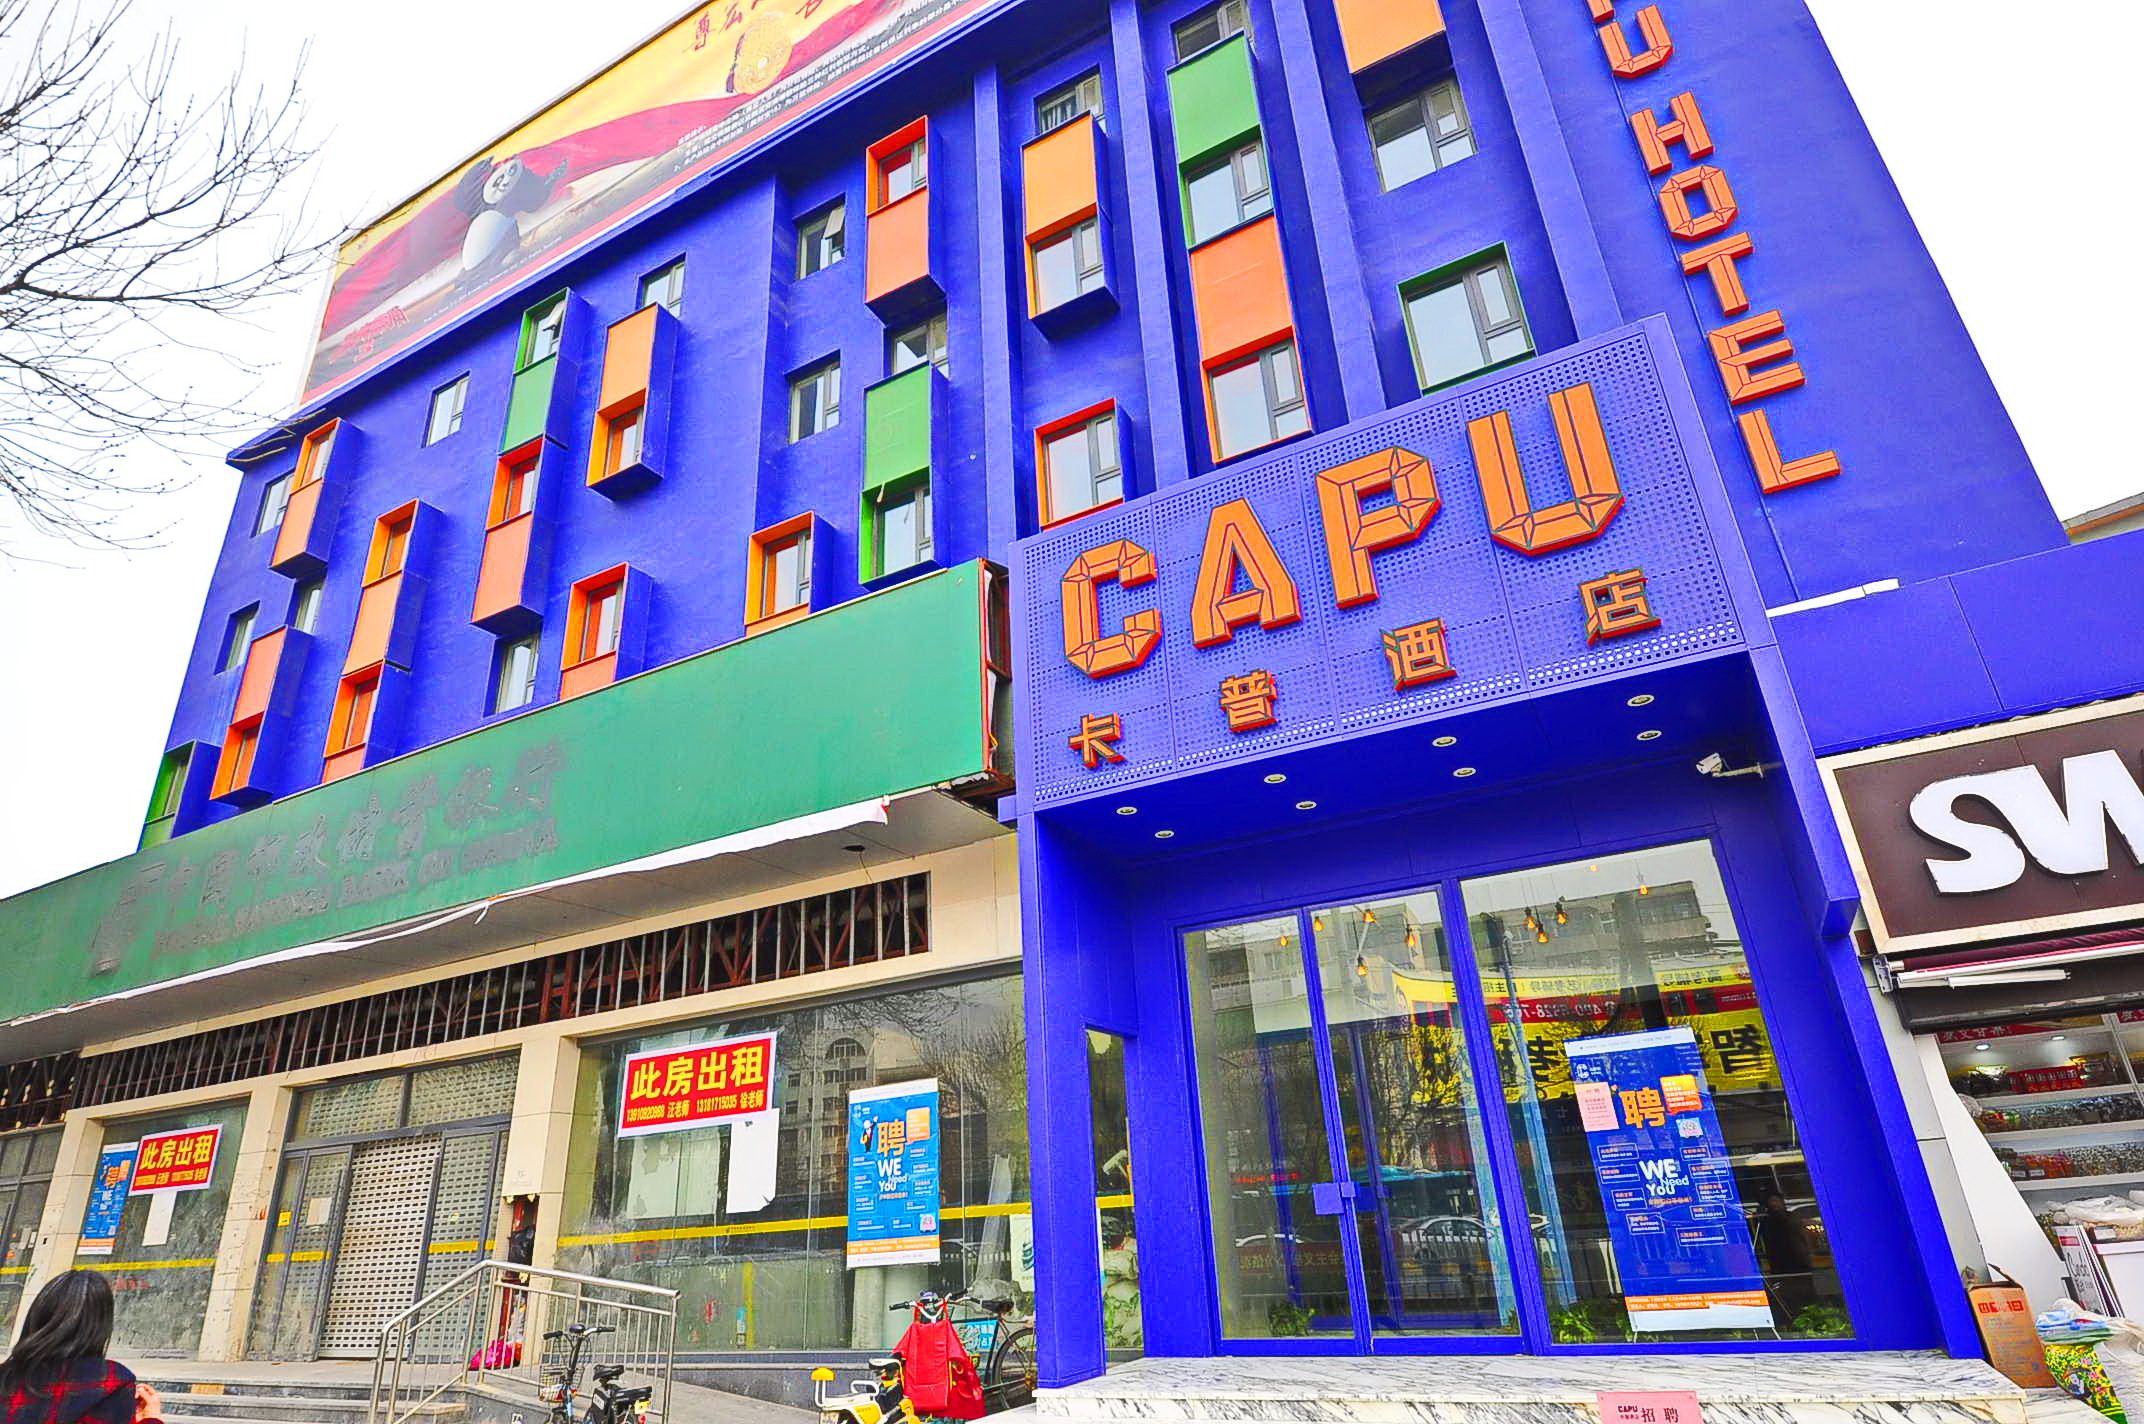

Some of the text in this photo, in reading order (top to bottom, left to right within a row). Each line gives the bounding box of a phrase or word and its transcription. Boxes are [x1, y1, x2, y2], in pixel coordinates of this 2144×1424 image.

[1629, 91, 1842, 494] HOTEL
[1062, 382, 1625, 679] CAPU
[1069, 567, 1662, 768] 卡普酒店
[629, 1044, 765, 1101] 此房出租
[1618, 1087, 1666, 1129] 聘
[139, 1134, 214, 1171] 此房出租
[877, 1118, 906, 1157] 聘
[878, 1157, 902, 1178] WE
[1638, 1158, 1678, 1180] WE
[1660, 1175, 1690, 1187] Need
